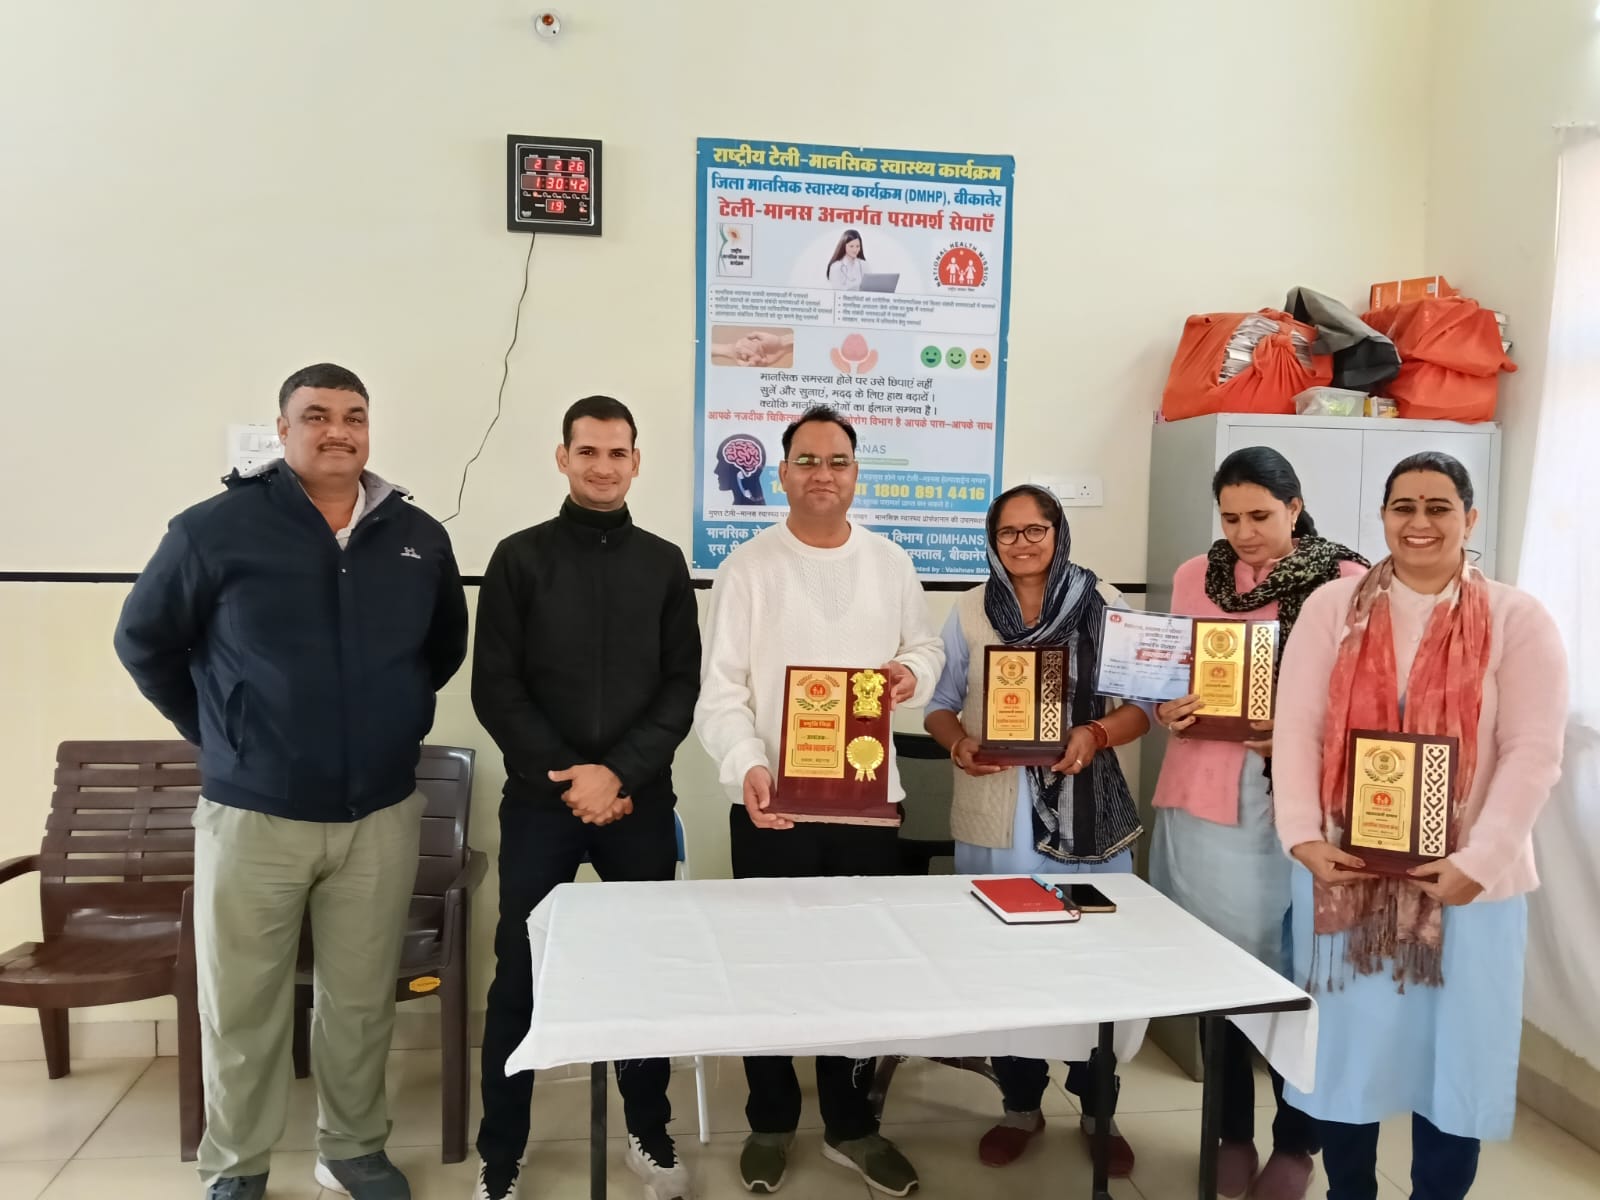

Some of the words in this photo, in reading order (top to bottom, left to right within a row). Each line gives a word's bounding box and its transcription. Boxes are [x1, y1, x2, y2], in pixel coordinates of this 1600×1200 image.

[568, 161, 583, 171] 26
[713, 144, 766, 167] राष्ट्रीय
[880, 158, 936, 177] स्वास्थ्य
[938, 159, 1002, 180] कार्यक्रम
[711, 171, 745, 190] जिला
[748, 174, 802, 193] मानसिक
[805, 181, 850, 197] स्वास्थ्य
[852, 182, 902, 200] कार्यक्रम
[550, 202, 562, 211] 19
[818, 205, 882, 225] अन्तर्गत
[888, 209, 944, 230] परामर्श
[949, 241, 978, 251] HEALTH
[760, 371, 798, 383] मानसिक
[801, 374, 833, 385] समस्या
[836, 374, 852, 386] होने
[855, 377, 868, 387] पर
[870, 376, 885, 387] उसे
[916, 378, 933, 390] नहीं
[760, 385, 776, 398] सुनें
[779, 385, 796, 396] और
[832, 389, 852, 399] मदद
[855, 388, 864, 399] के
[867, 389, 884, 400] लिए
[887, 391, 903, 401] हाथ
[853, 402, 865, 412] का
[854, 444, 887, 455] ANAS
[874, 483, 910, 498] 1800
[947, 486, 985, 500] 4416
[706, 524, 749, 539] मानसिक
[892, 529, 923, 544] विभाग
